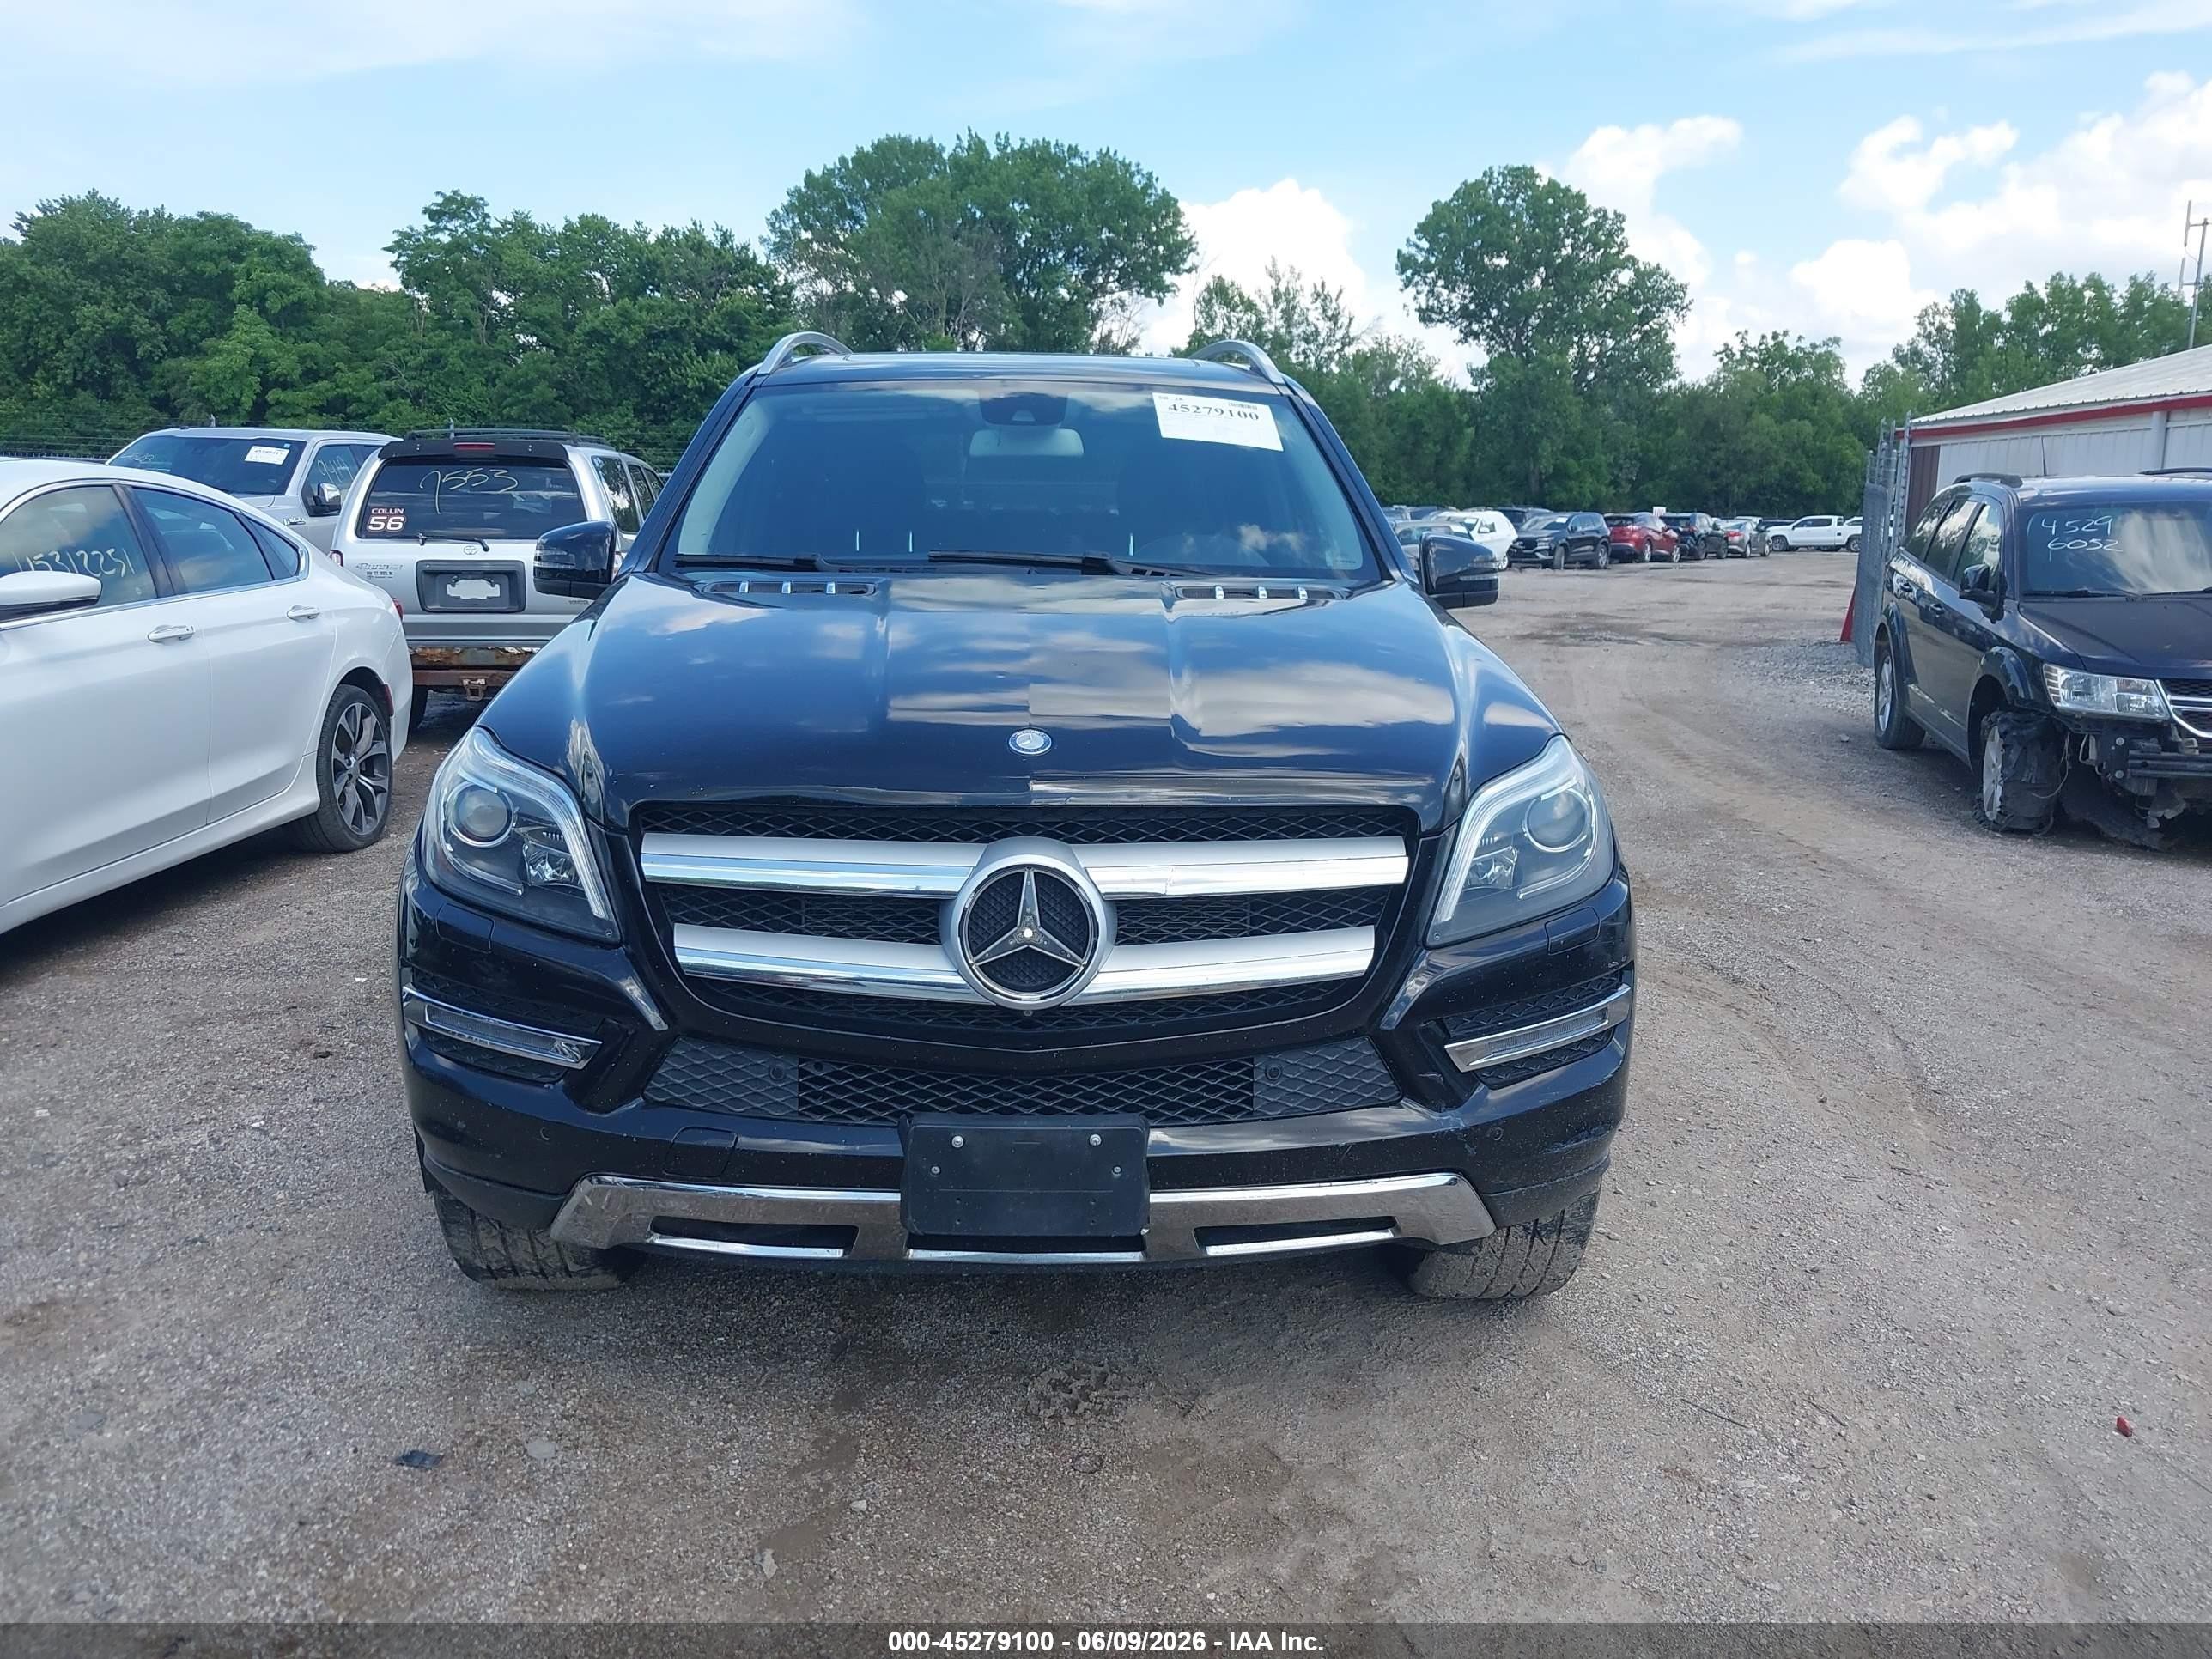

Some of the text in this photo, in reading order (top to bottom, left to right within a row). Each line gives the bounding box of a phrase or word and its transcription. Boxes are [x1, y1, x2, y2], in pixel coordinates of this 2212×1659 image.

[1168, 403, 1260, 421] 45279100
[368, 515, 406, 532] 56
[2041, 515, 2114, 536] 4529
[2047, 538, 2124, 553] 6052
